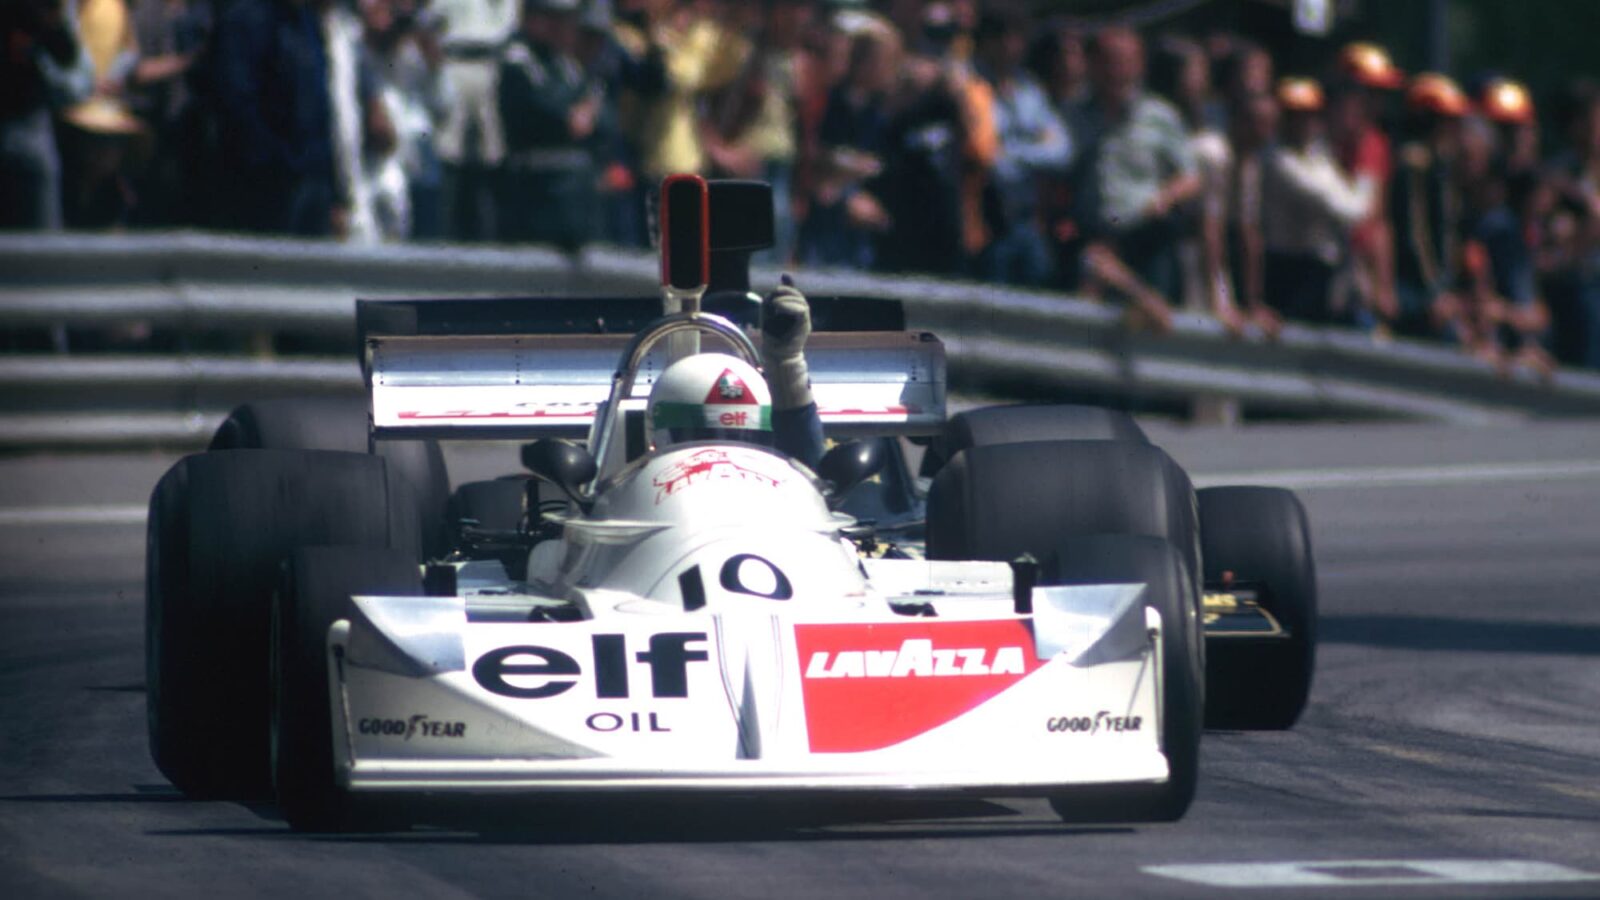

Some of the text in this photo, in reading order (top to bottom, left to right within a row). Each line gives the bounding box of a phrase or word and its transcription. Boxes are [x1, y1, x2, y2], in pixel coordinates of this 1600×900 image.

[720, 411, 748, 426] elf
[677, 553, 793, 612] 10
[471, 632, 709, 699] elf
[805, 638, 1025, 678] LAVAZZA
[585, 712, 671, 732] OIL
